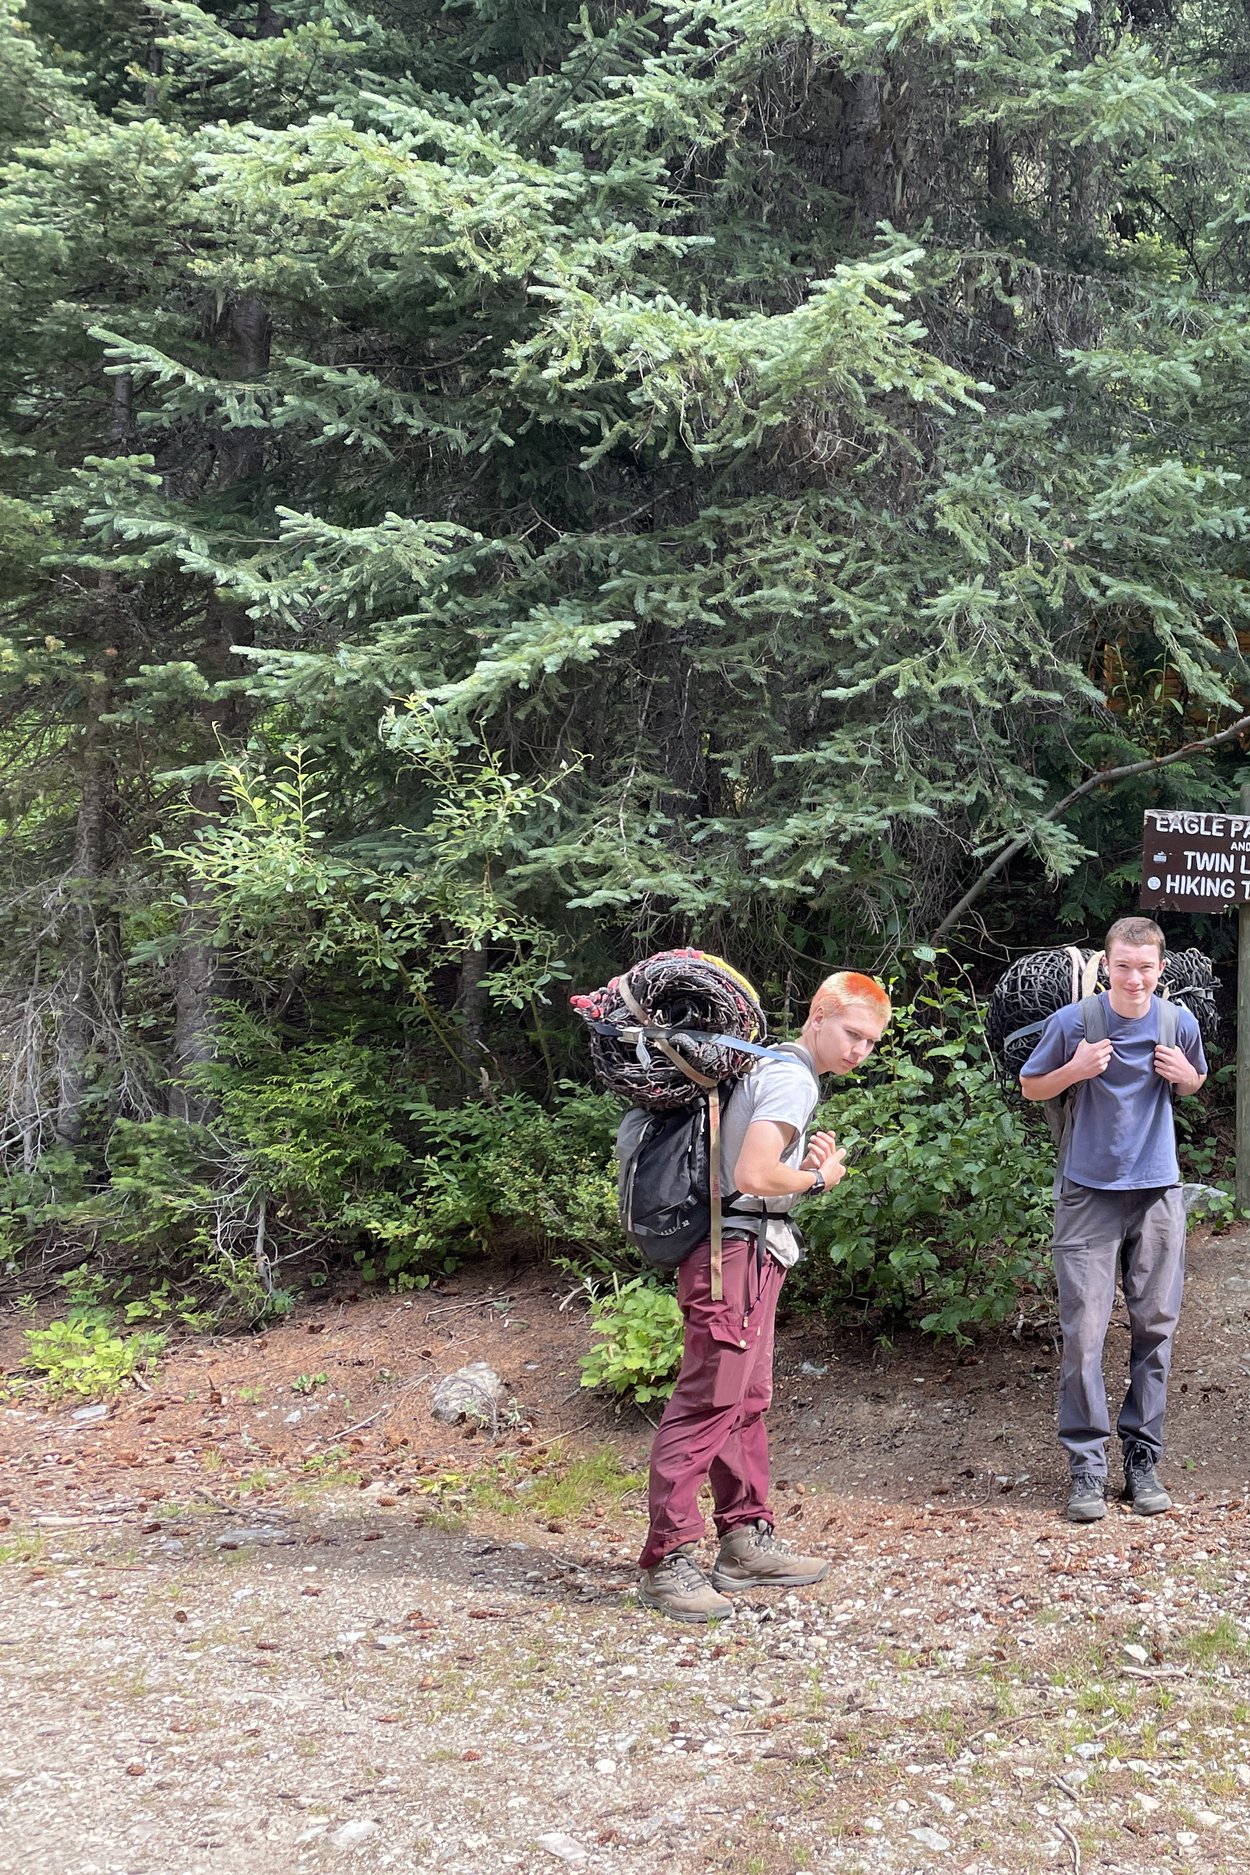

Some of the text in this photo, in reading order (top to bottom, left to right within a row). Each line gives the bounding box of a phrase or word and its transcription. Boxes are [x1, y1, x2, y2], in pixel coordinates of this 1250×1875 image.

[1156, 815, 1225, 837] EAGLE
[1183, 850, 1235, 873] TWIN
[1166, 874, 1236, 898] HIKING
